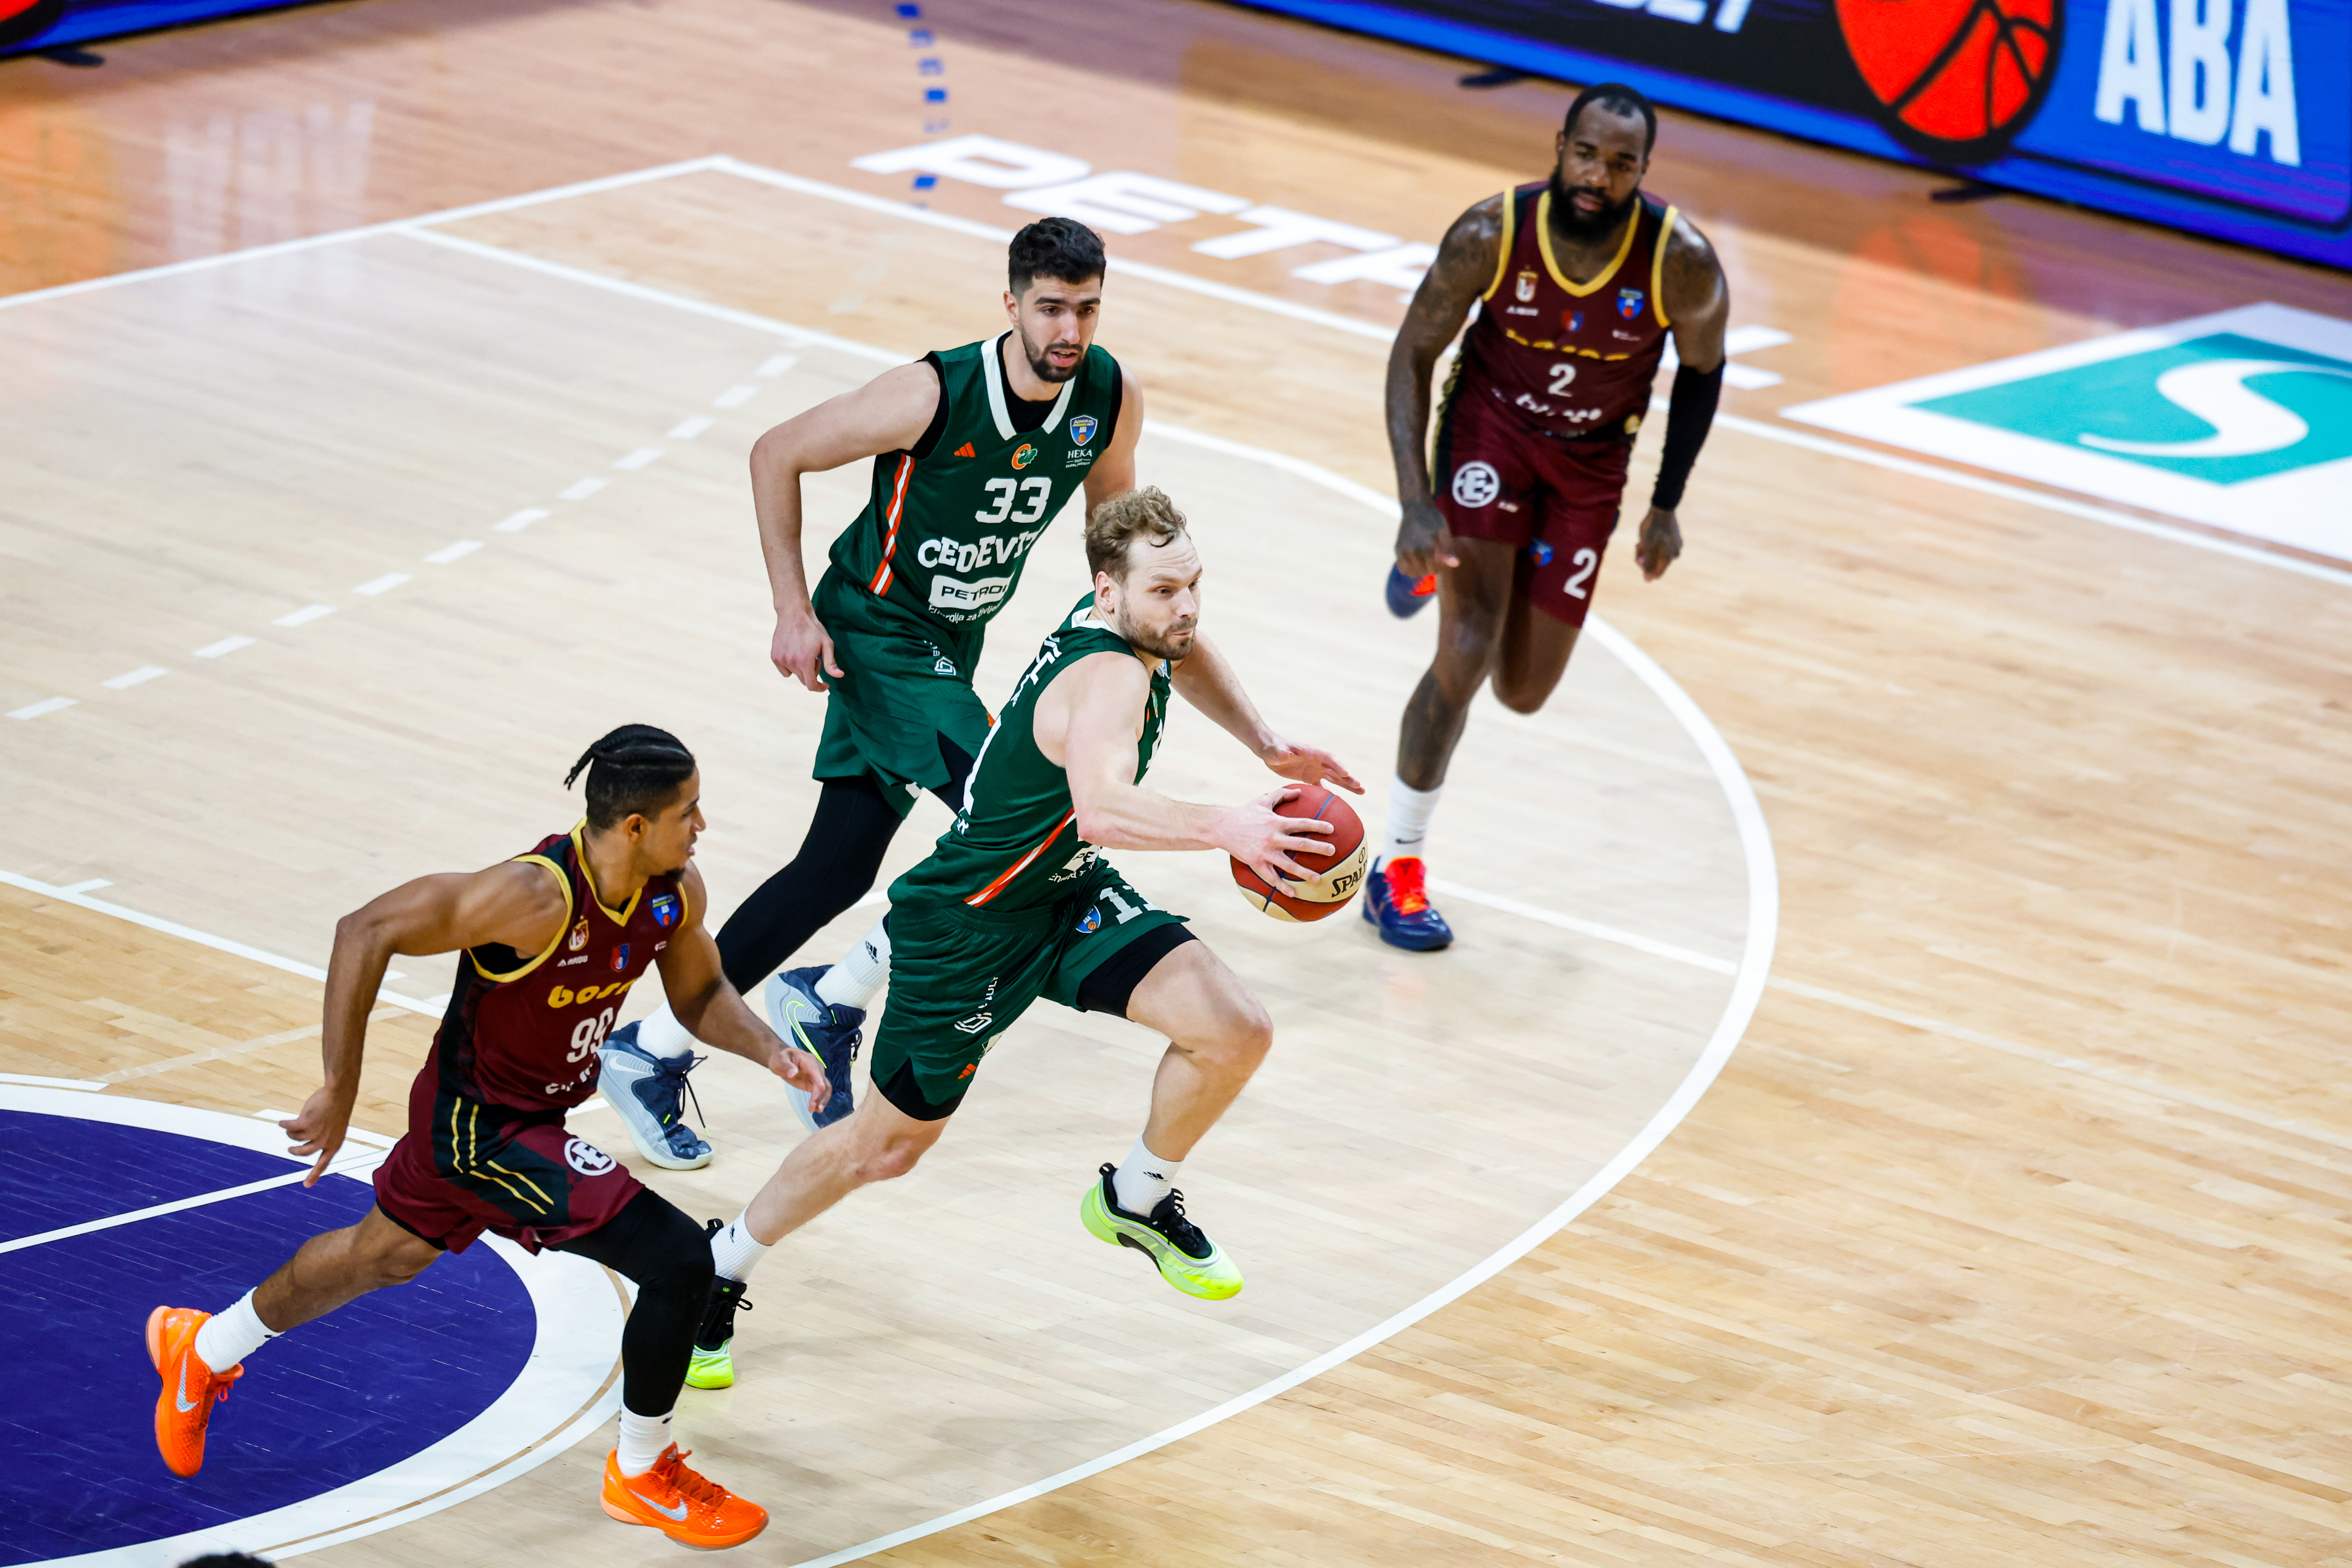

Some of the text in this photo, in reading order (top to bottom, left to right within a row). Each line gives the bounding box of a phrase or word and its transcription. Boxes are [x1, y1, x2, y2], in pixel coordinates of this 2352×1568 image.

[2093, 0, 2301, 167] ABA
[1547, 363, 1576, 397] 2
[1067, 449, 1093, 459] HEKA
[975, 476, 1052, 524] 33
[1563, 547, 1598, 600] 2
[566, 1007, 614, 1063] 99
